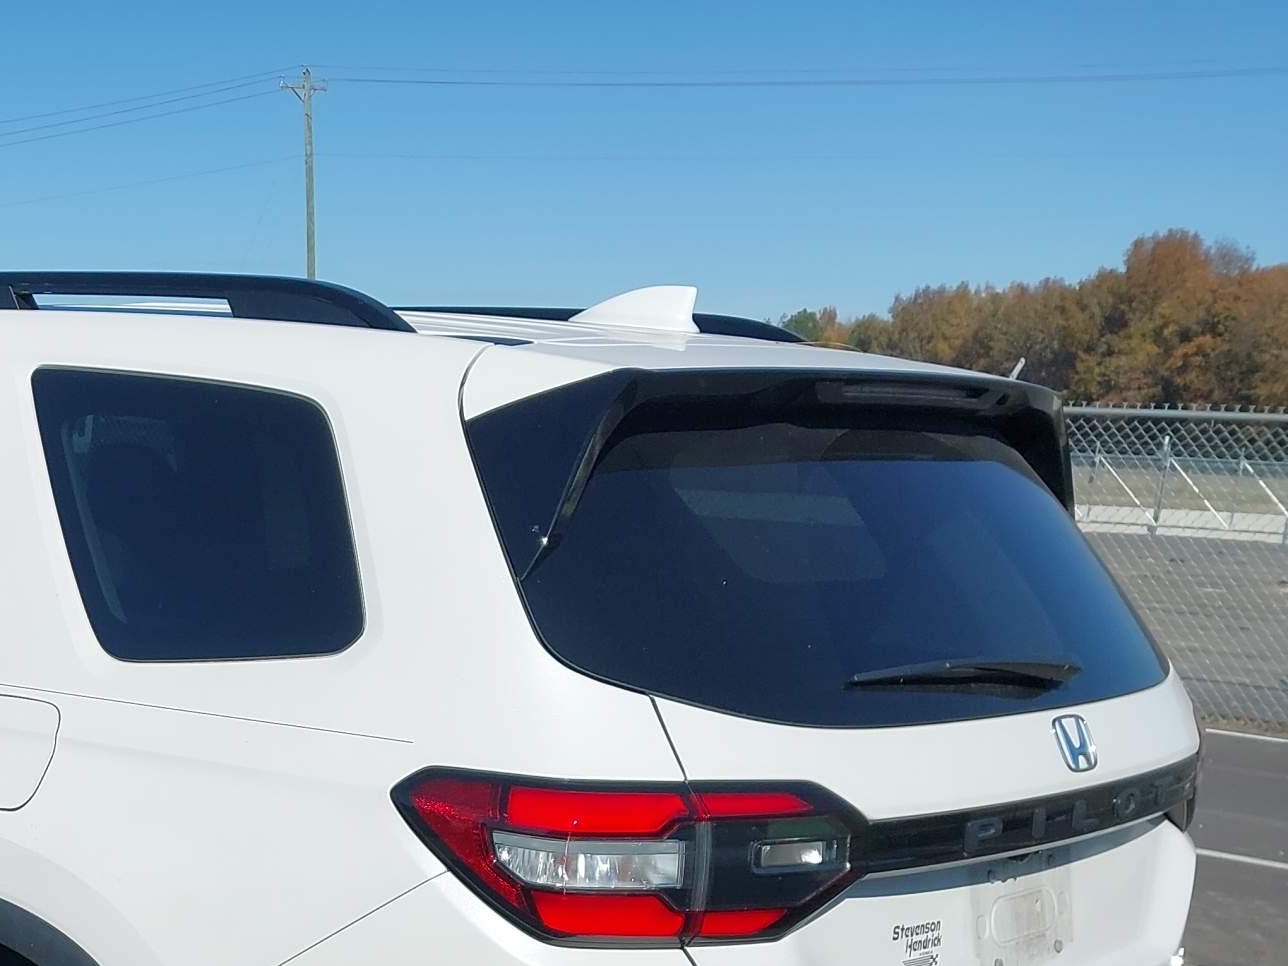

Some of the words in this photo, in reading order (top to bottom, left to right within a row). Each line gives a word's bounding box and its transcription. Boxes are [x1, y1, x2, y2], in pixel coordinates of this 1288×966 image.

[963, 775, 1175, 857] PILOT
[892, 920, 941, 941] Stevenson
[905, 932, 942, 958] Hendrick
